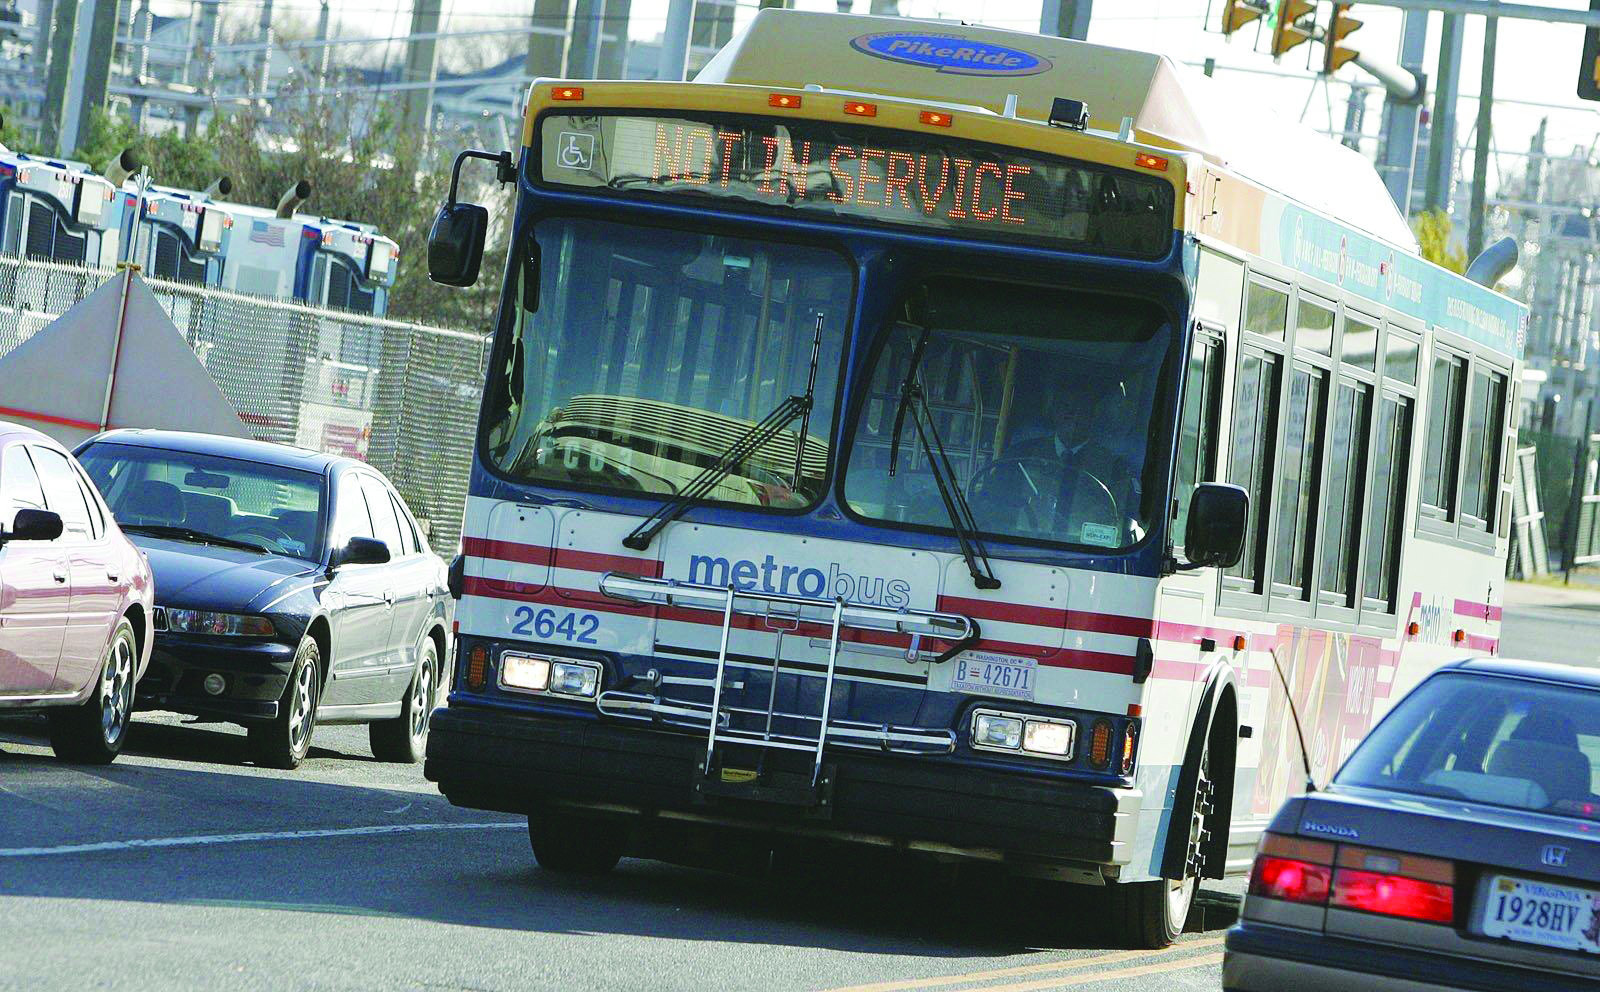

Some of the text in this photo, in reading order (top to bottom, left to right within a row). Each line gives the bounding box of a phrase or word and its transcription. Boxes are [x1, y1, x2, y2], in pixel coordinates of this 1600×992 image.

[887, 40, 1022, 67] PikeRide
[651, 123, 1032, 225] NOT IN SERVICE
[688, 553, 911, 608] metrobus
[511, 605, 600, 644] 2642
[957, 660, 1029, 690] B 42671
[1304, 821, 1360, 838] HONDA
[1523, 884, 1582, 902] VIRGINIA
[1495, 895, 1581, 933] 1928HV
